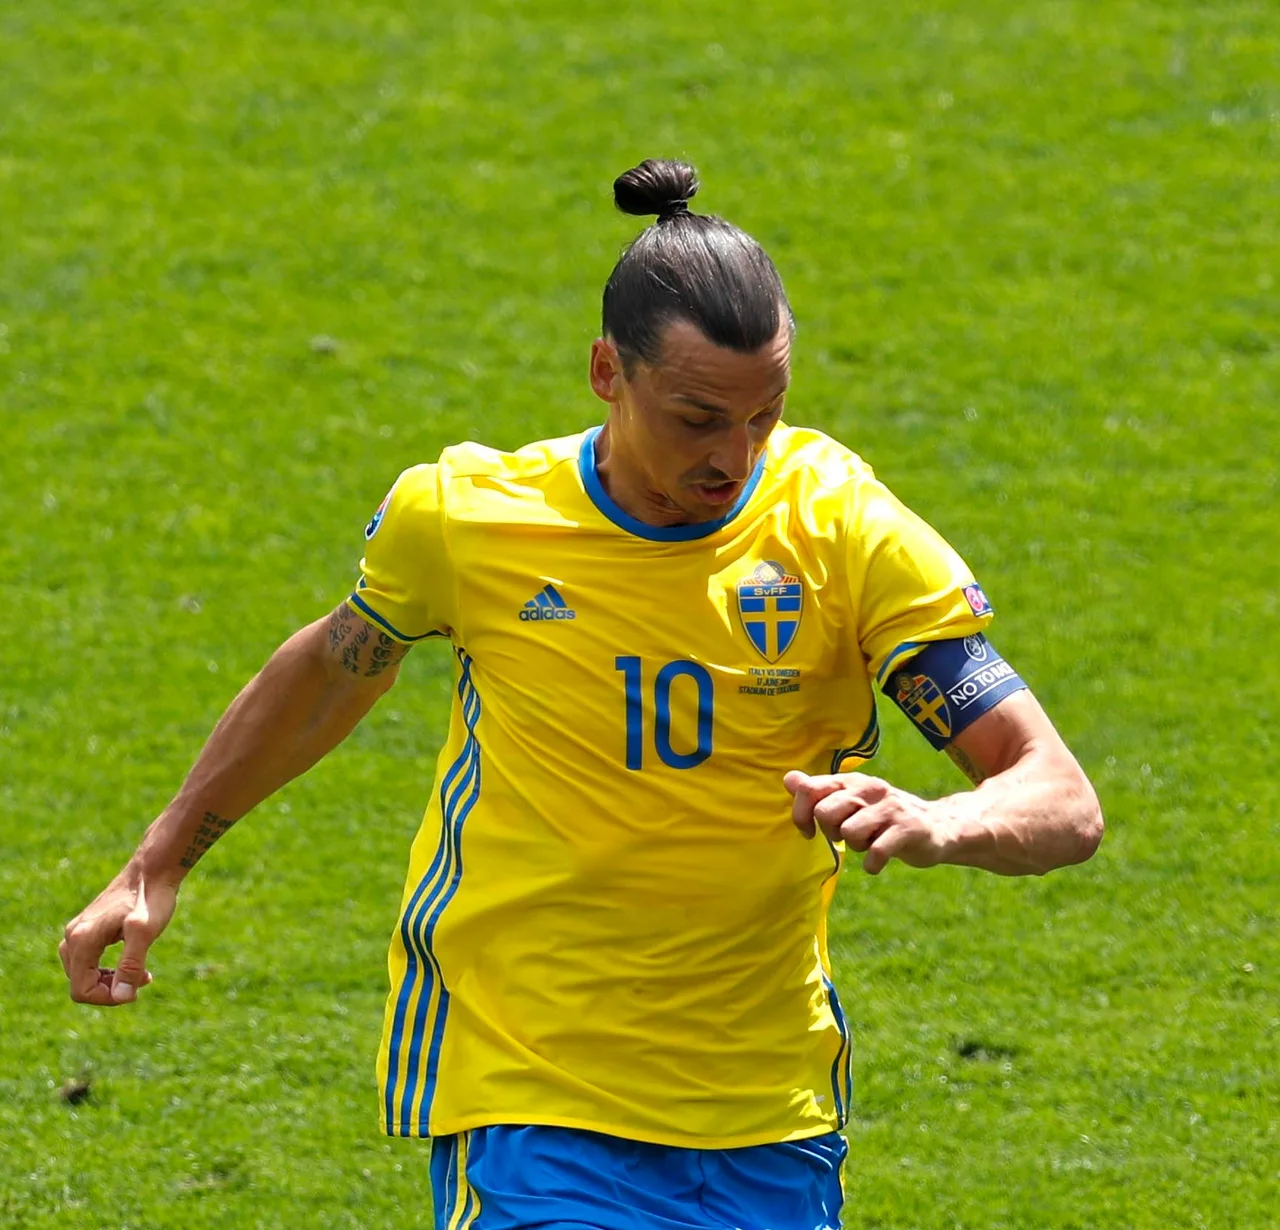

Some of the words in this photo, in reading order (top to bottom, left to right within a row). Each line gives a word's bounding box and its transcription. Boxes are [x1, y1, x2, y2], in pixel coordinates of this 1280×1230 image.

[754, 587, 787, 595] SvFF
[518, 608, 576, 621] adidas
[748, 667, 766, 676] ITALY
[950, 682, 977, 706] NO
[974, 671, 996, 687] TO
[615, 655, 713, 771] 10
